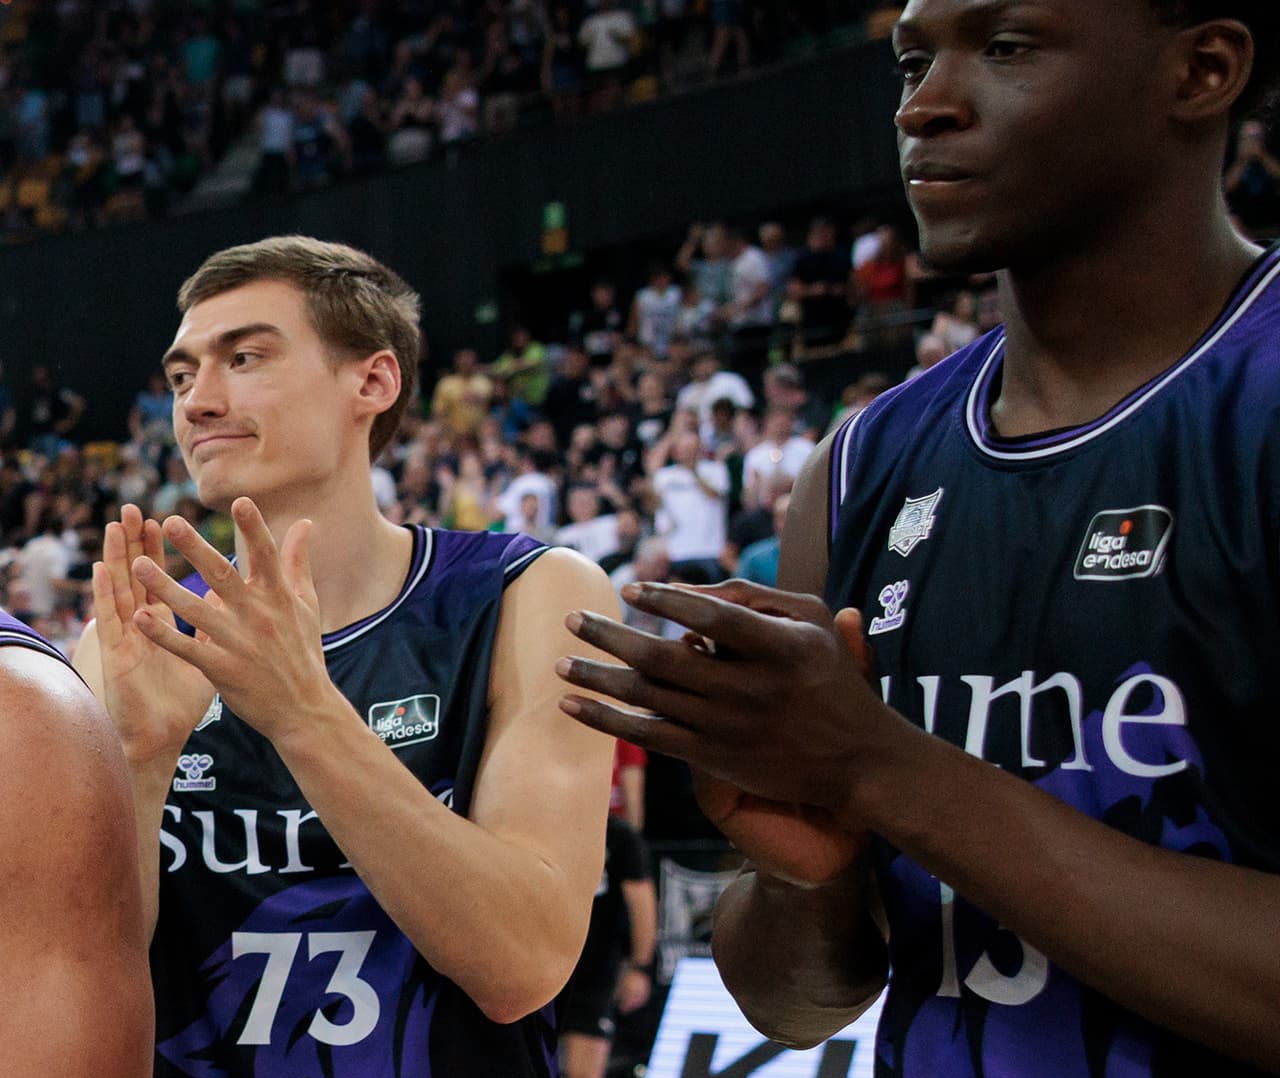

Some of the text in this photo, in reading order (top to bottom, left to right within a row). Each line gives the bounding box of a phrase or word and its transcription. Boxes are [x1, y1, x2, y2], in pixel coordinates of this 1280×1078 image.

[1089, 532, 1126, 553] liga
[1083, 548, 1151, 570] endesa
[377, 715, 402, 732] liga
[175, 779, 214, 789] hummel
[231, 931, 381, 1046] 73
